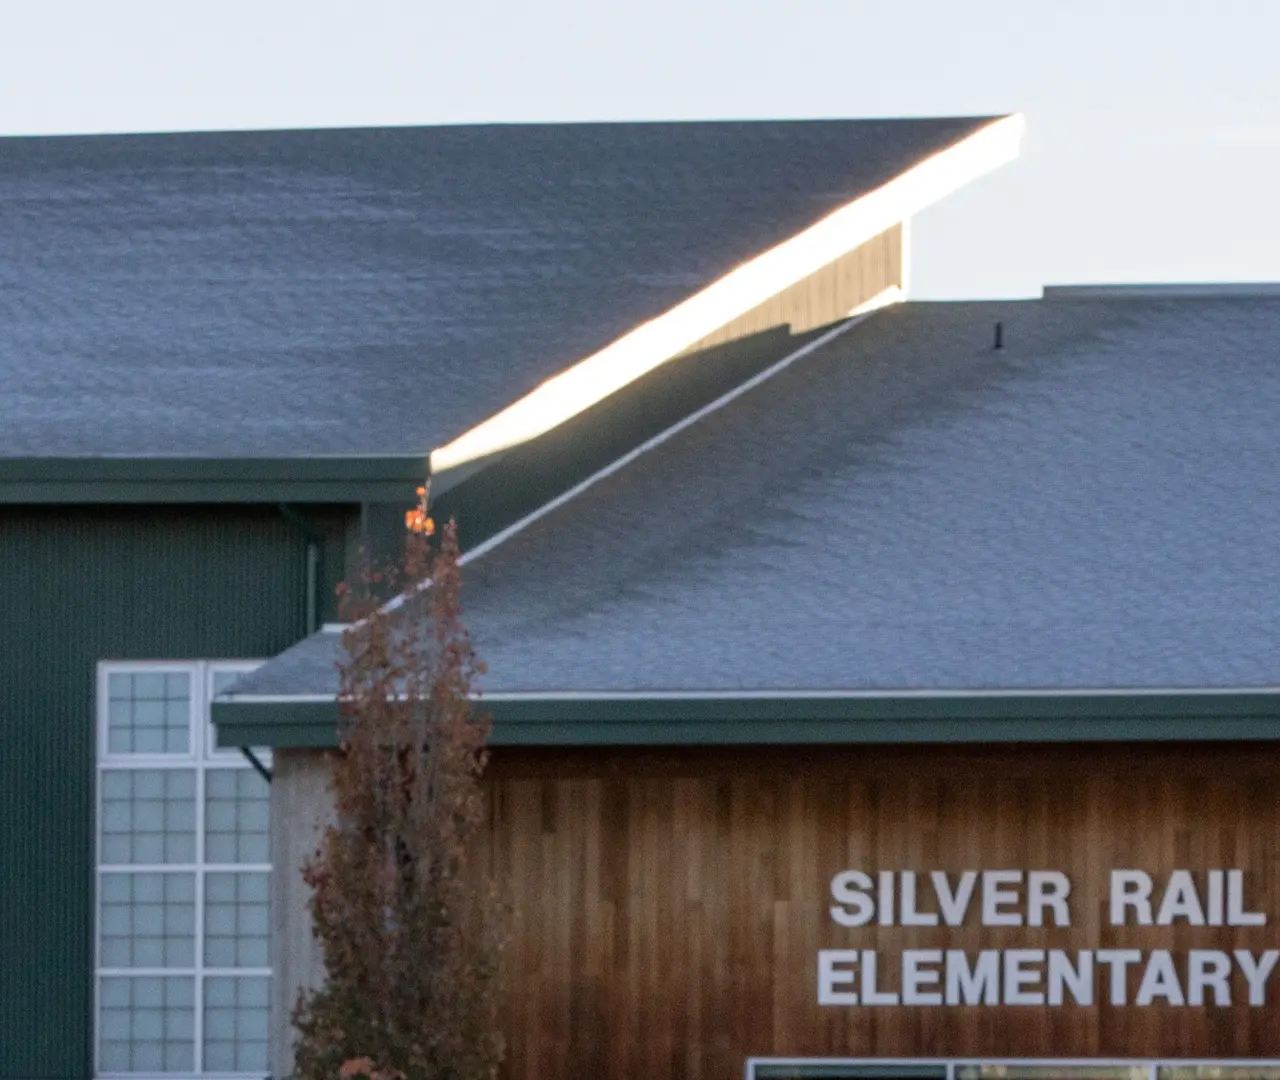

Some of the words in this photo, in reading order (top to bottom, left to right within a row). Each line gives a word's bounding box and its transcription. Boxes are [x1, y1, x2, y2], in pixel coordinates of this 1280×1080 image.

[829, 869, 1071, 927] SILVER
[1110, 869, 1267, 927] RAIL
[817, 949, 1280, 1006] ELEMENTARY
